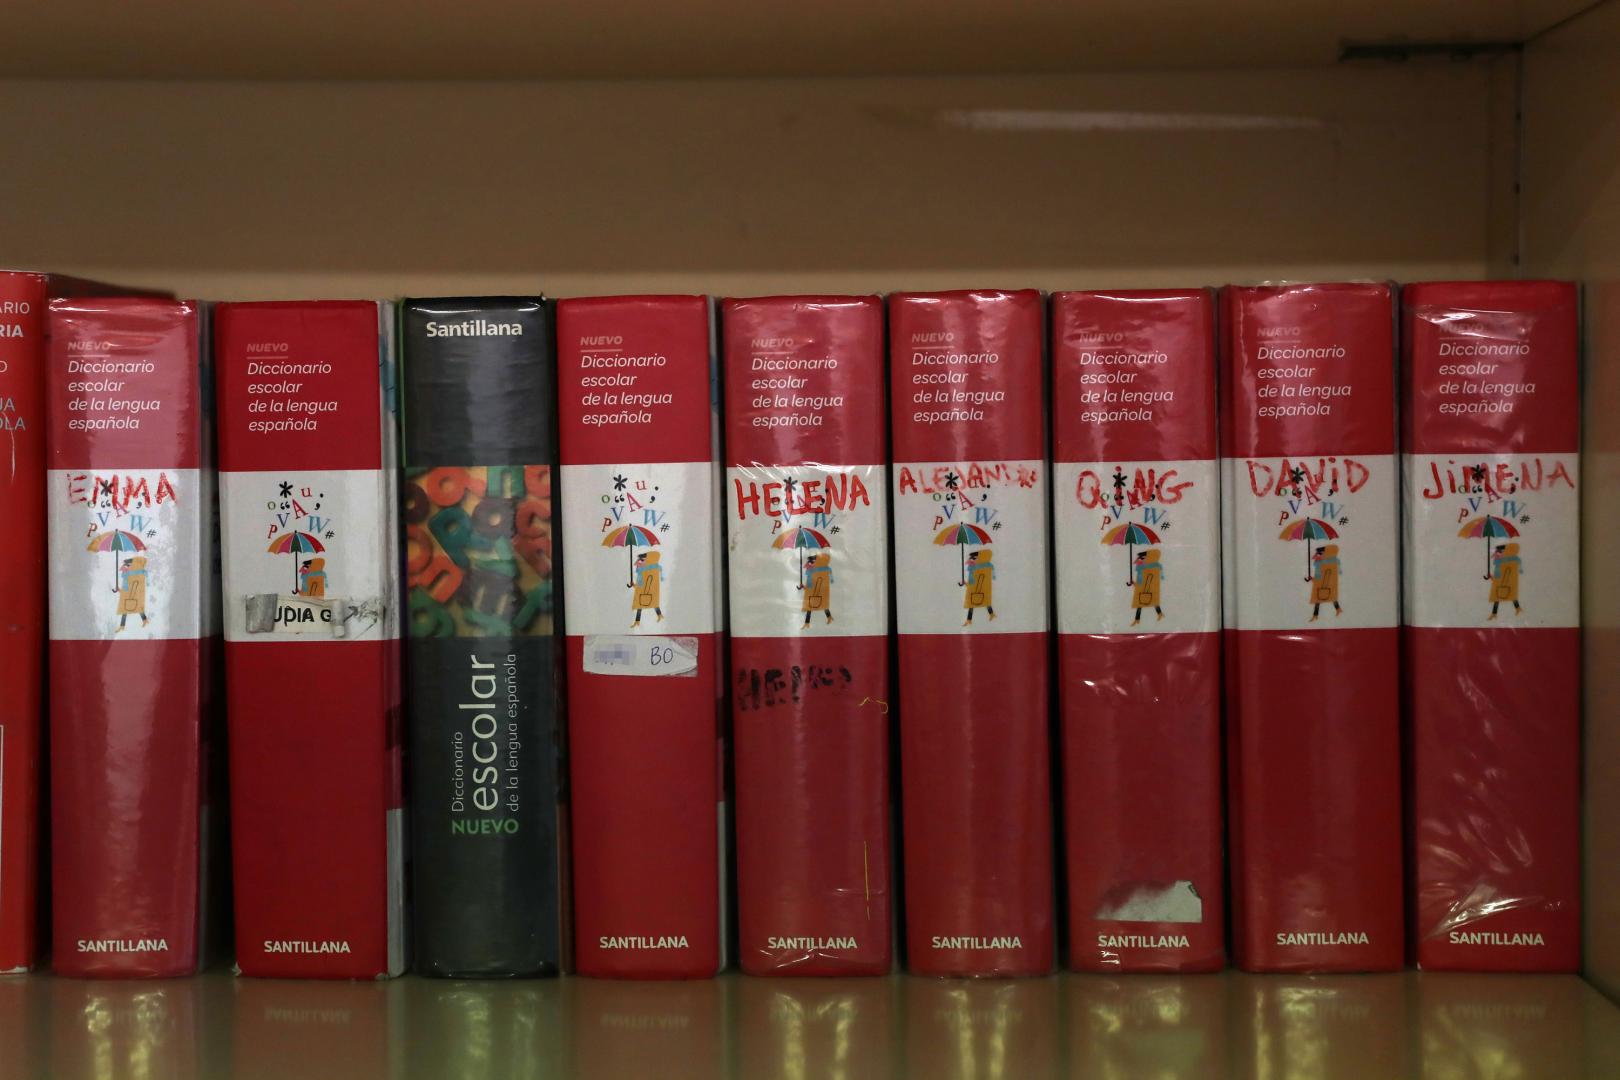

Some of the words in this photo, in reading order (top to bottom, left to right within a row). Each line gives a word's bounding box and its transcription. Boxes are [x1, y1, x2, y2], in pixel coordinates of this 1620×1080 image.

[426, 320, 523, 337] Santillana
[580, 336, 623, 346] NUEVO
[751, 338, 794, 348] NUEVO
[911, 332, 954, 343] NUEVO
[67, 341, 111, 351] NUEVO
[246, 343, 289, 352] NUEVO
[1257, 345, 1345, 360] Diccionario
[1439, 341, 1530, 356] Diccionario
[581, 353, 666, 368] Diccionario
[751, 356, 838, 371] Diccionario
[912, 350, 999, 366] Diccionario
[1080, 350, 1167, 365] Diccionario
[68, 359, 154, 373] Diccionario
[247, 361, 332, 375] Diccionario
[1257, 365, 1316, 379] escolar
[1439, 361, 1499, 375] escolar
[581, 373, 637, 387] escolar
[751, 375, 808, 389] escolar
[912, 370, 968, 384] escolar
[1080, 370, 1137, 384] escolar
[68, 379, 124, 392] escolar
[247, 380, 302, 394] escolar
[1258, 384, 1277, 398] de
[1280, 383, 1295, 398] la
[1298, 383, 1352, 399] lengua
[1439, 381, 1458, 394] de
[1462, 381, 1477, 394] la
[1480, 381, 1536, 397] lengua
[582, 392, 601, 406] de
[603, 392, 617, 405] la
[620, 391, 673, 408] lengua
[752, 395, 771, 409] de
[774, 394, 788, 408] la
[791, 394, 844, 410] lengua
[913, 390, 933, 403] de
[935, 389, 949, 403] la
[952, 389, 1005, 405] lengua
[1081, 389, 1100, 403] de
[1103, 389, 1117, 403] la
[1120, 389, 1174, 405] lengua
[68, 398, 87, 411] de
[90, 398, 105, 411] la
[108, 398, 161, 414] lengua
[248, 400, 267, 412] de
[270, 399, 283, 412] la
[286, 399, 338, 415] lengua
[1258, 402, 1330, 419] española
[1439, 400, 1514, 416] española
[68, 416, 139, 432] española
[582, 410, 652, 428] española
[752, 413, 823, 430] española
[913, 408, 984, 425] española
[1081, 408, 1152, 425] española
[248, 418, 318, 434] española
[734, 473, 870, 520] HELENA
[503, 654, 520, 718] española
[458, 654, 498, 811] escolar
[505, 723, 521, 771] lengua
[451, 731, 464, 812] Diccionario
[505, 776, 519, 789] la
[506, 794, 519, 812] de
[451, 818, 519, 834] NUEVO
[77, 938, 168, 953] SANTILLANA
[599, 936, 689, 949] SANTILLANA
[767, 936, 858, 950] SANTILLANA
[931, 936, 1022, 949] SANTILLANA
[1098, 935, 1190, 948] SANTILLANA
[1276, 932, 1369, 946] SANTILLANA
[1449, 931, 1545, 946] SANTILLANA
[264, 940, 350, 953] SANTILLANA
